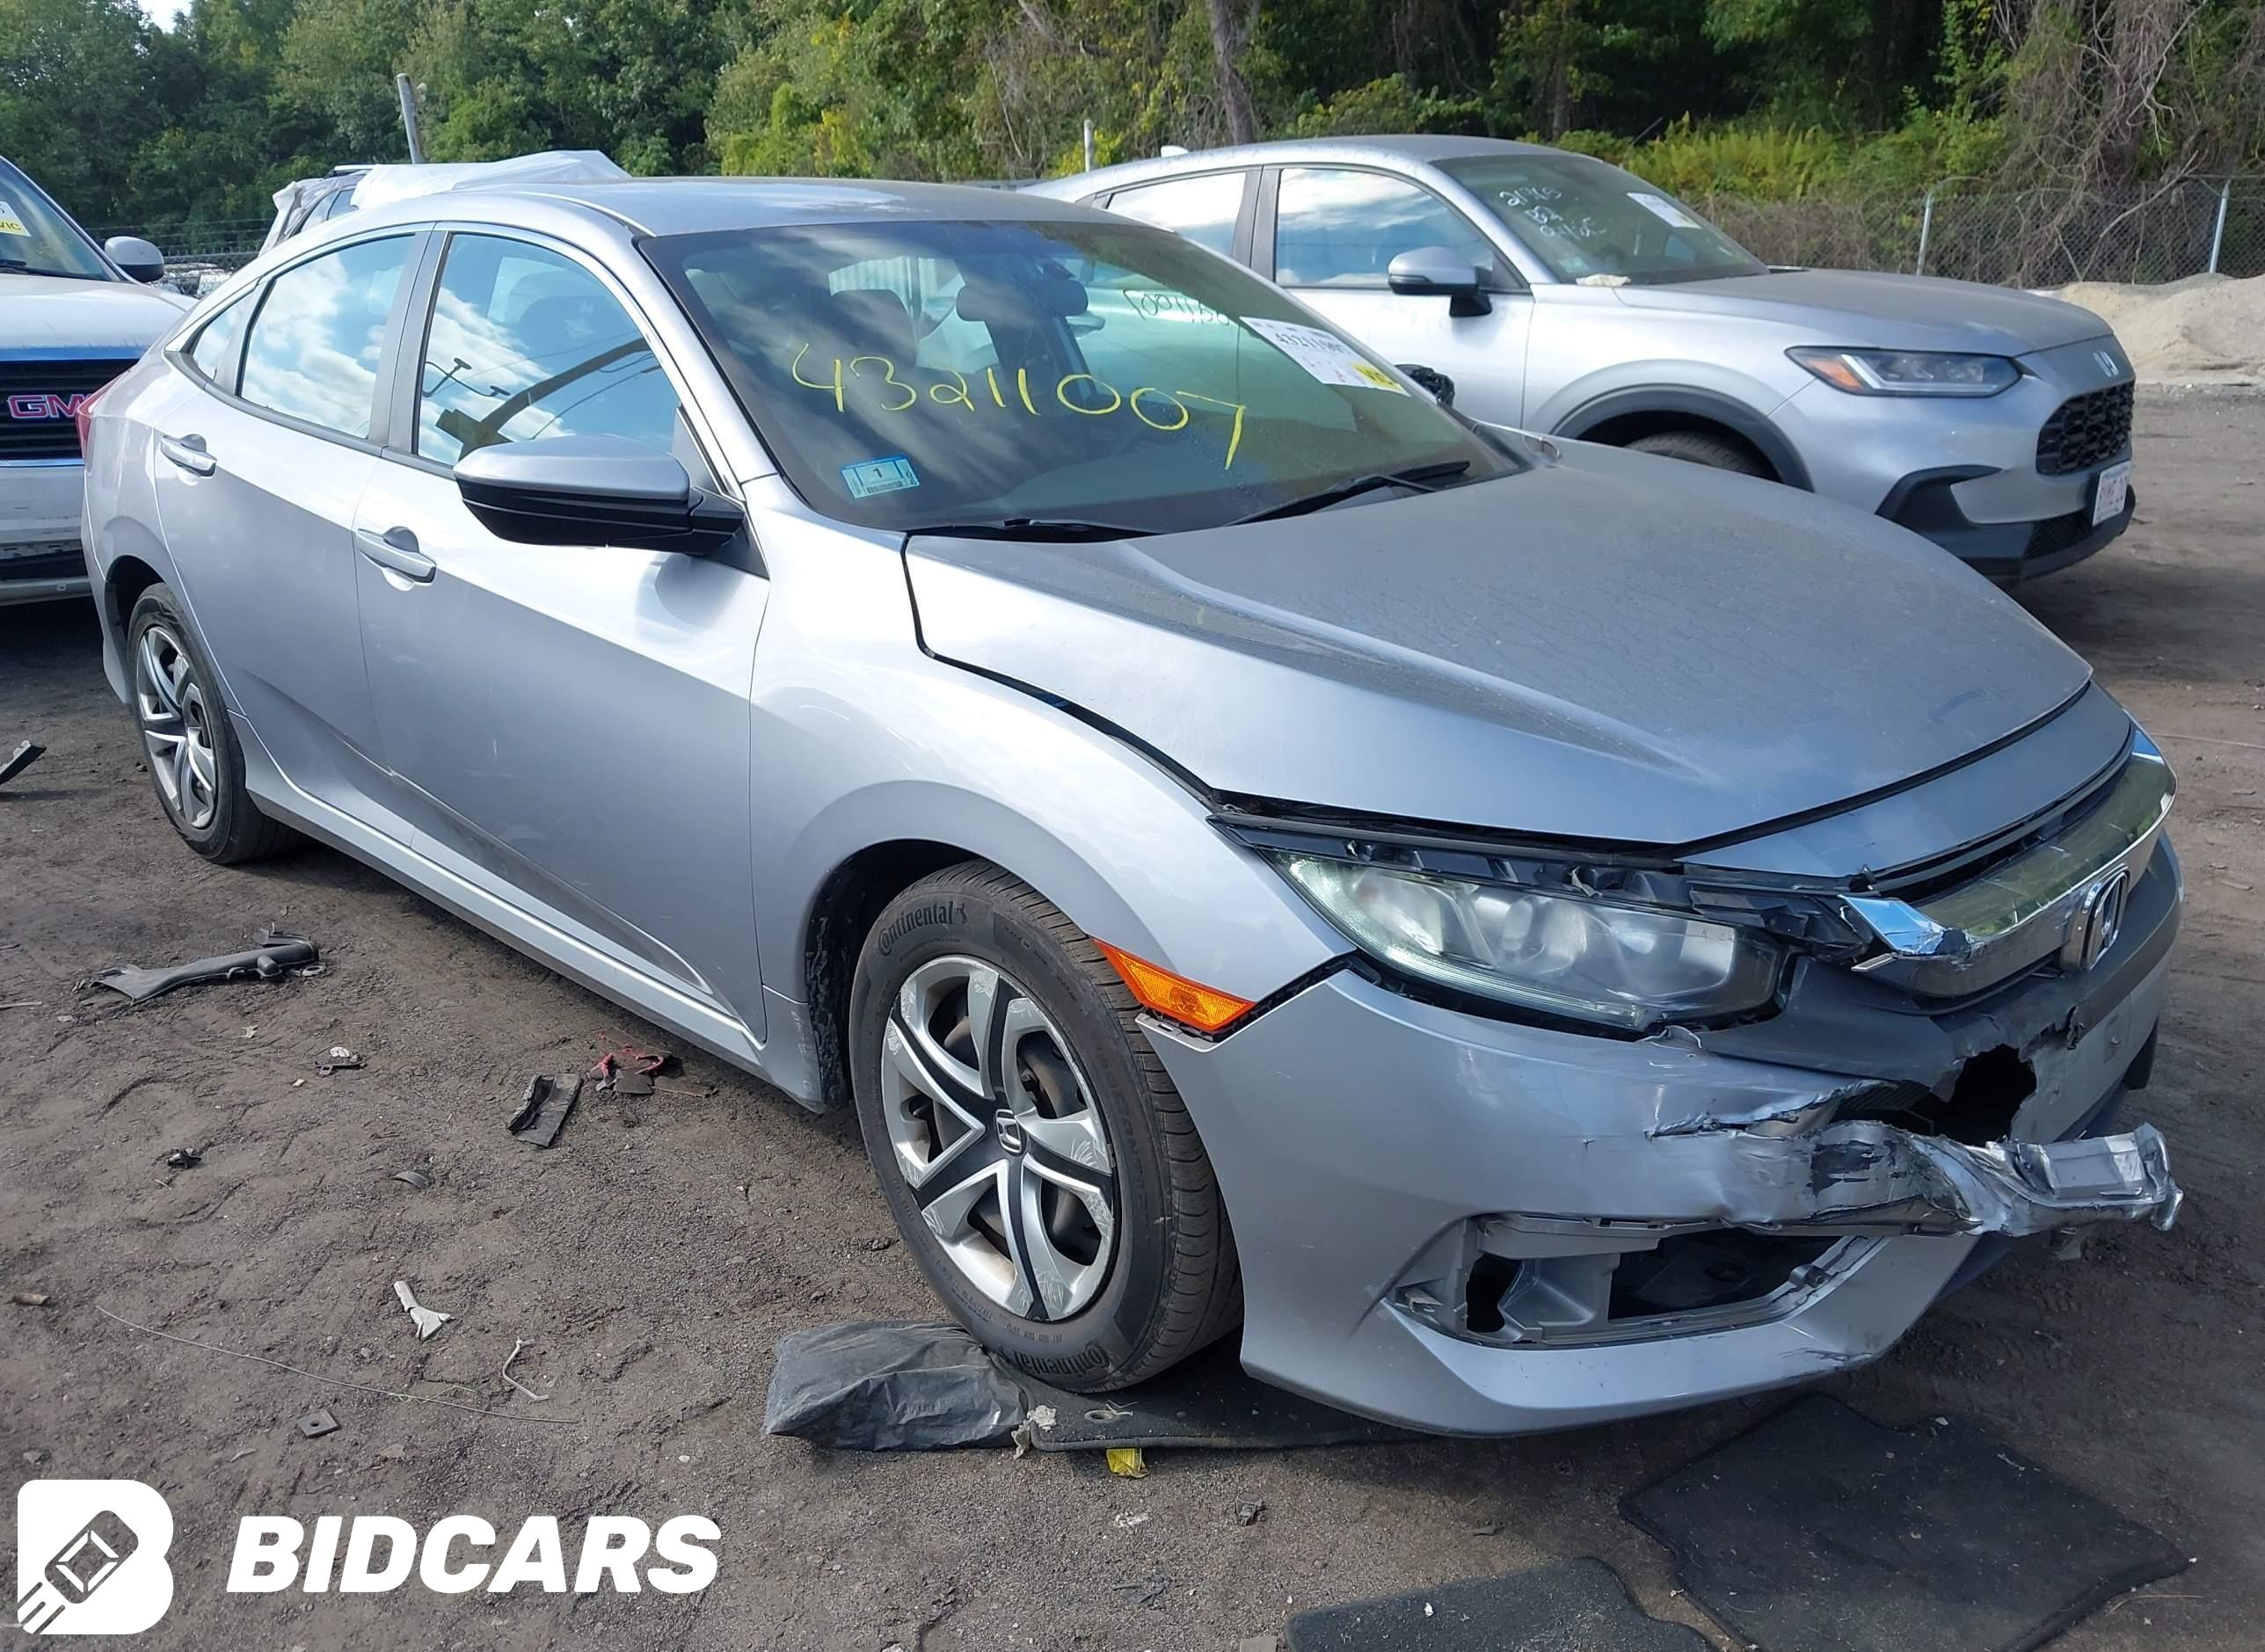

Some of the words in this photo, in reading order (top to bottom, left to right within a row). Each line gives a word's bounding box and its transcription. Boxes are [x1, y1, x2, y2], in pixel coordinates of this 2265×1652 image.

[7, 393, 92, 418] GM
[791, 343, 1246, 470] 43211007
[878, 900, 954, 957] Continental
